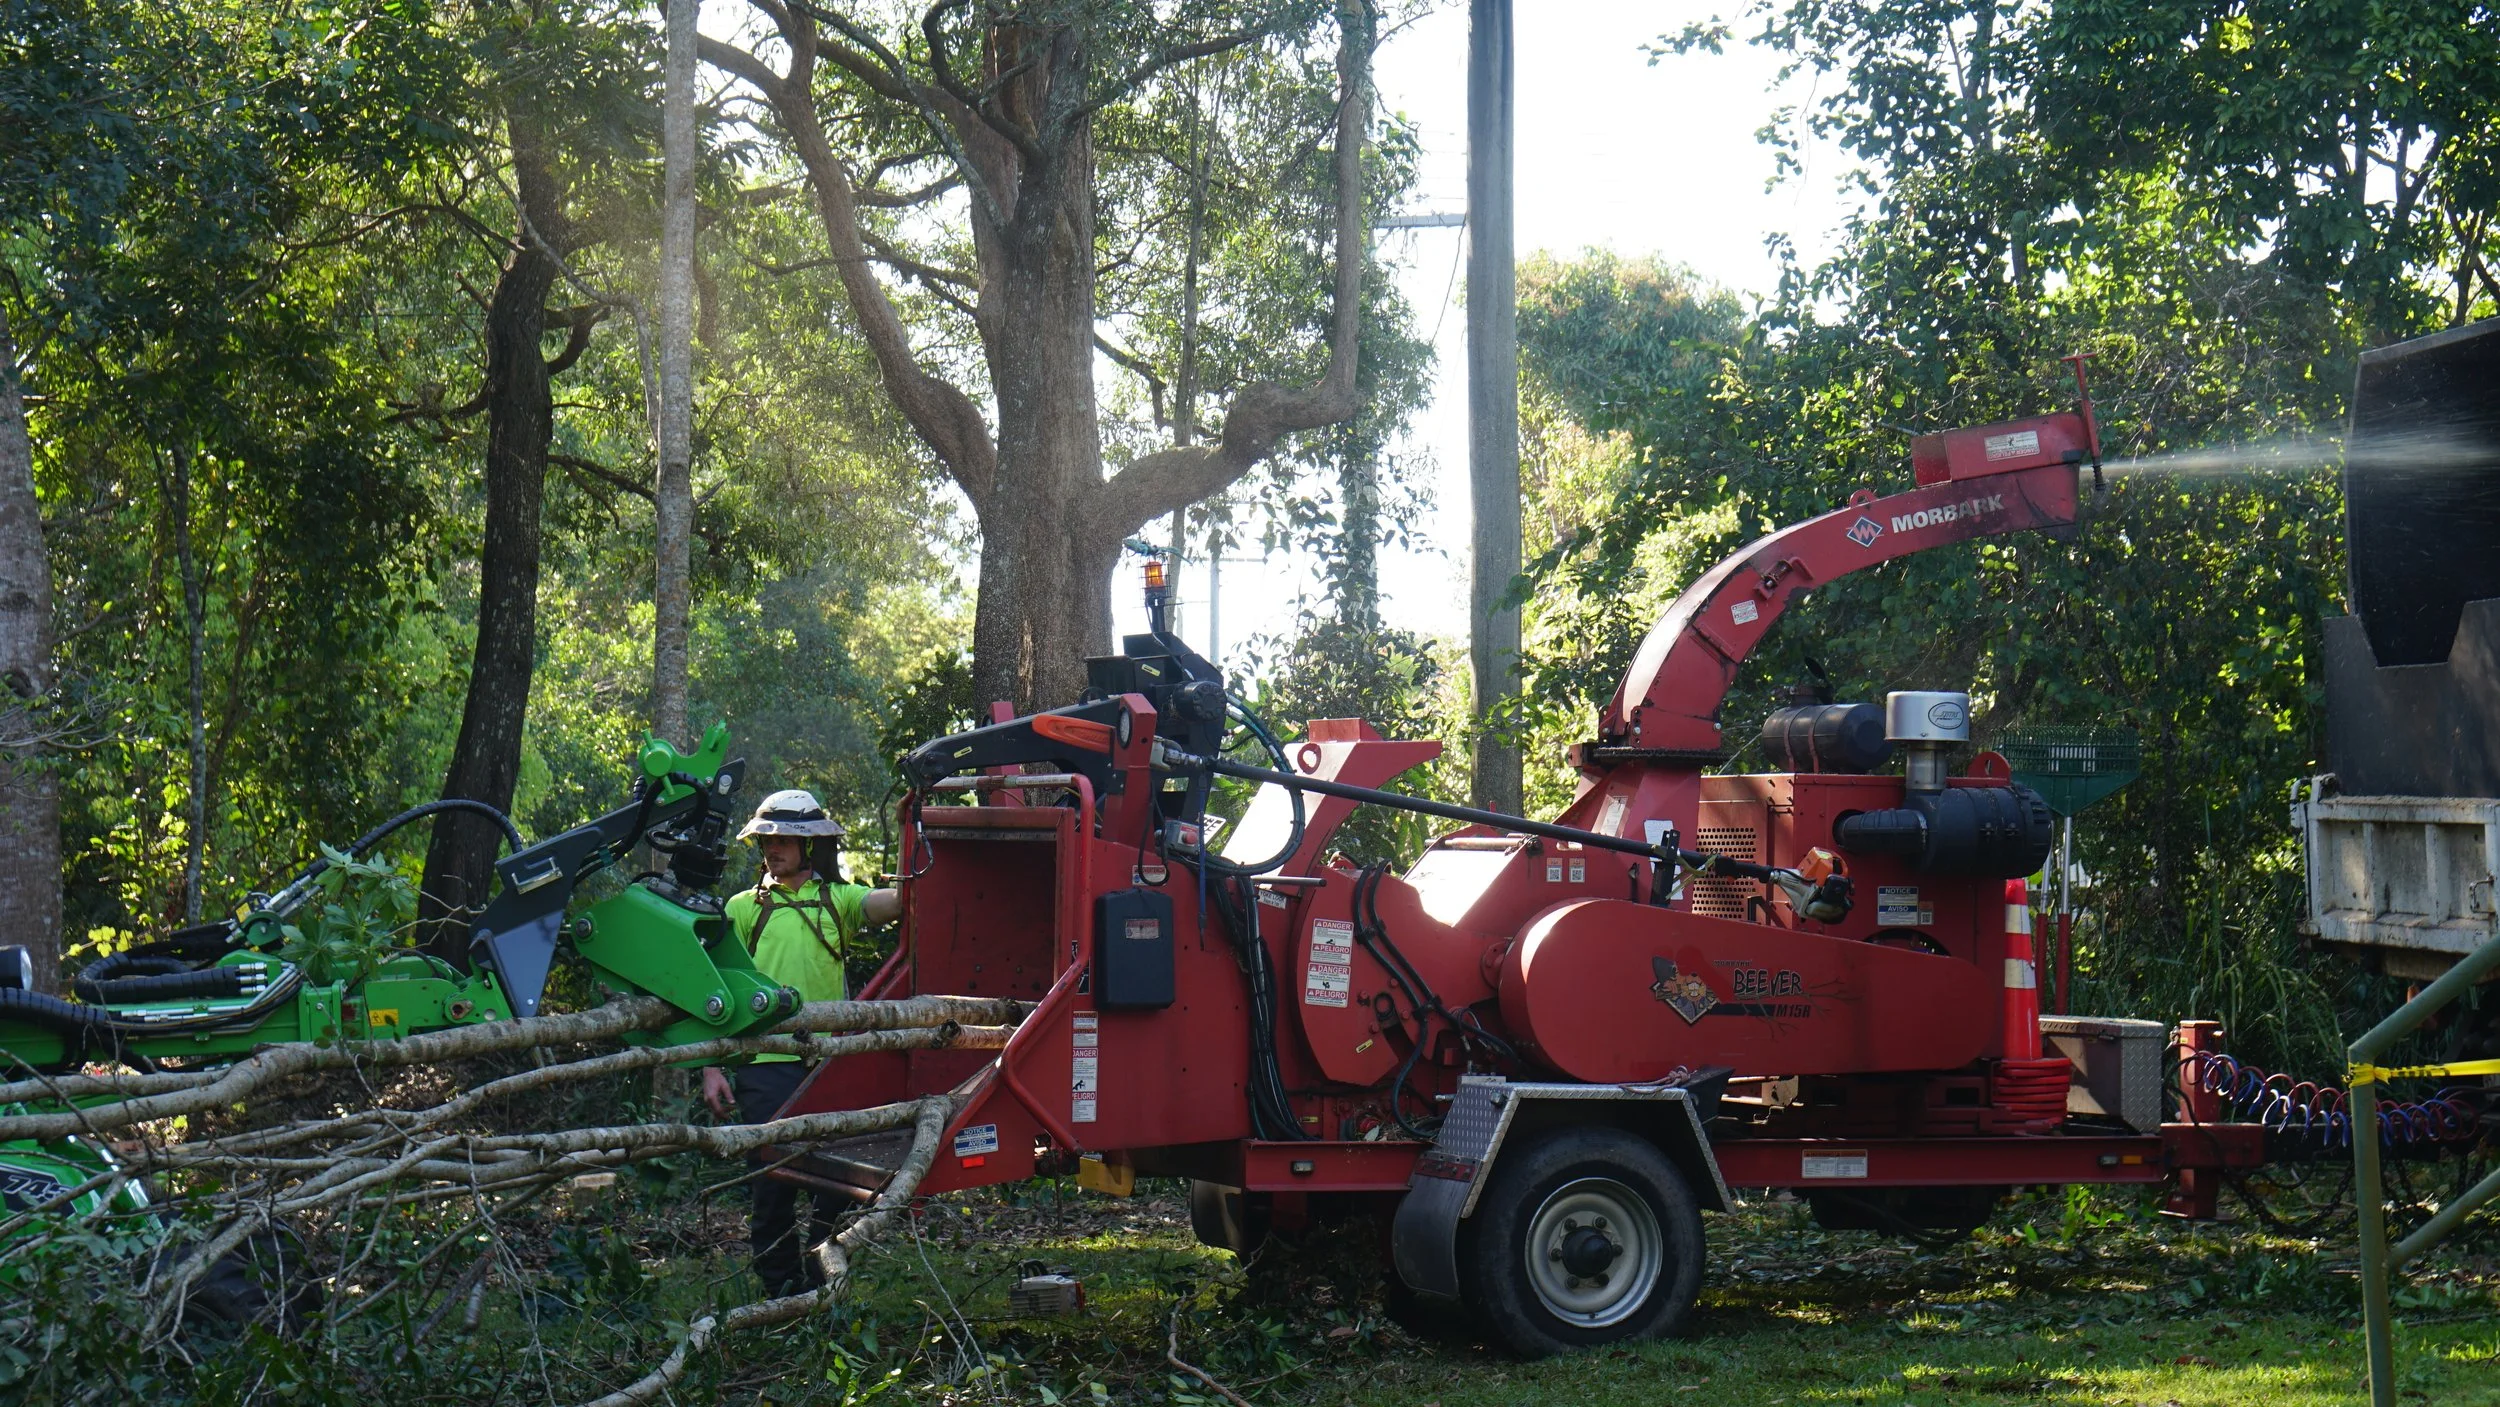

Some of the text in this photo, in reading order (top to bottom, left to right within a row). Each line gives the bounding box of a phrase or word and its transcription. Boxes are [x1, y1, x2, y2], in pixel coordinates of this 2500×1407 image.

[1891, 494, 2005, 533] MORBARK
[1322, 921, 1351, 930] DANGER
[1320, 945, 1350, 954] PELIGRO
[1318, 965, 1348, 975] DANGER
[1733, 967, 1803, 998] BEEVER
[1314, 990, 1346, 999] PELIGRO
[1072, 1092, 1095, 1100] ELIGRO
[964, 1127, 987, 1135] NOTICE
